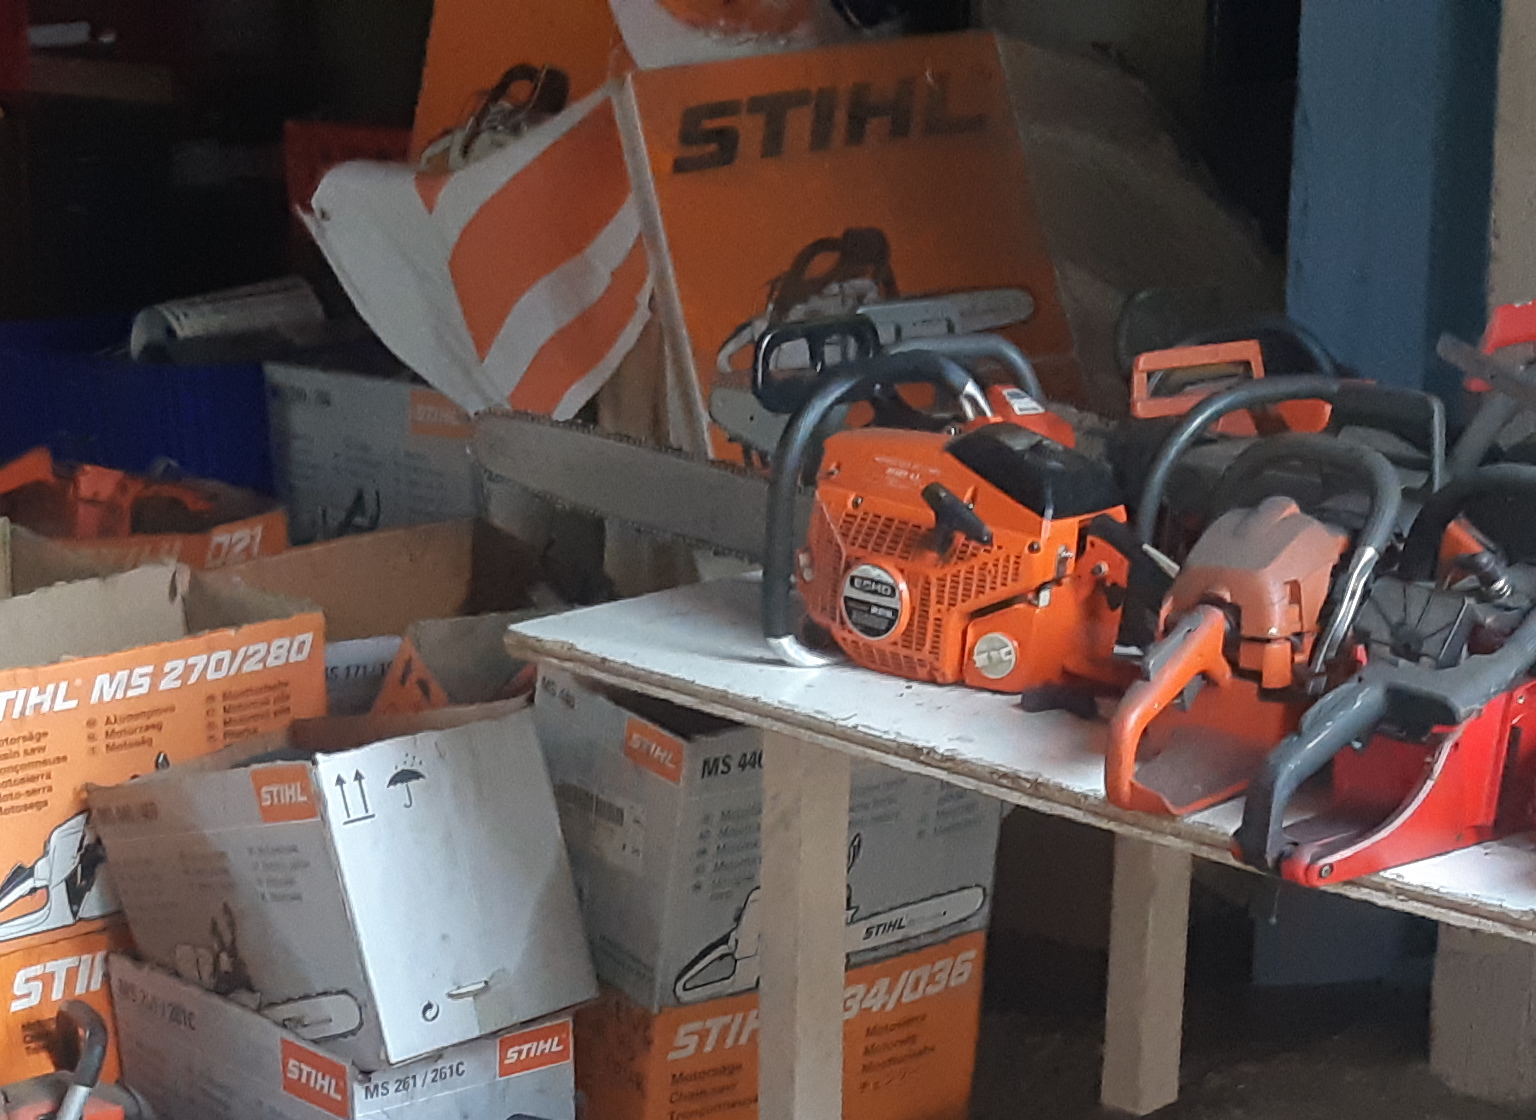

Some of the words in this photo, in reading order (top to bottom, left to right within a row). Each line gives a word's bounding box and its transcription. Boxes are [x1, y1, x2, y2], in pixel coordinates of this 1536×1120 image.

[673, 77, 989, 174] STIHL
[89, 664, 155, 705] MS
[158, 632, 313, 691] 270/280
[702, 754, 732, 779] MS
[261, 782, 308, 806] STIHL
[863, 917, 906, 941] STIHL
[10, 950, 107, 1013] STI
[843, 950, 977, 1021] 34/036
[504, 1036, 563, 1065] STIHL
[287, 1058, 342, 1101] STIHL
[364, 1080, 390, 1100] MS
[394, 1074, 417, 1095] 261
[431, 1061, 466, 1084] 261C
